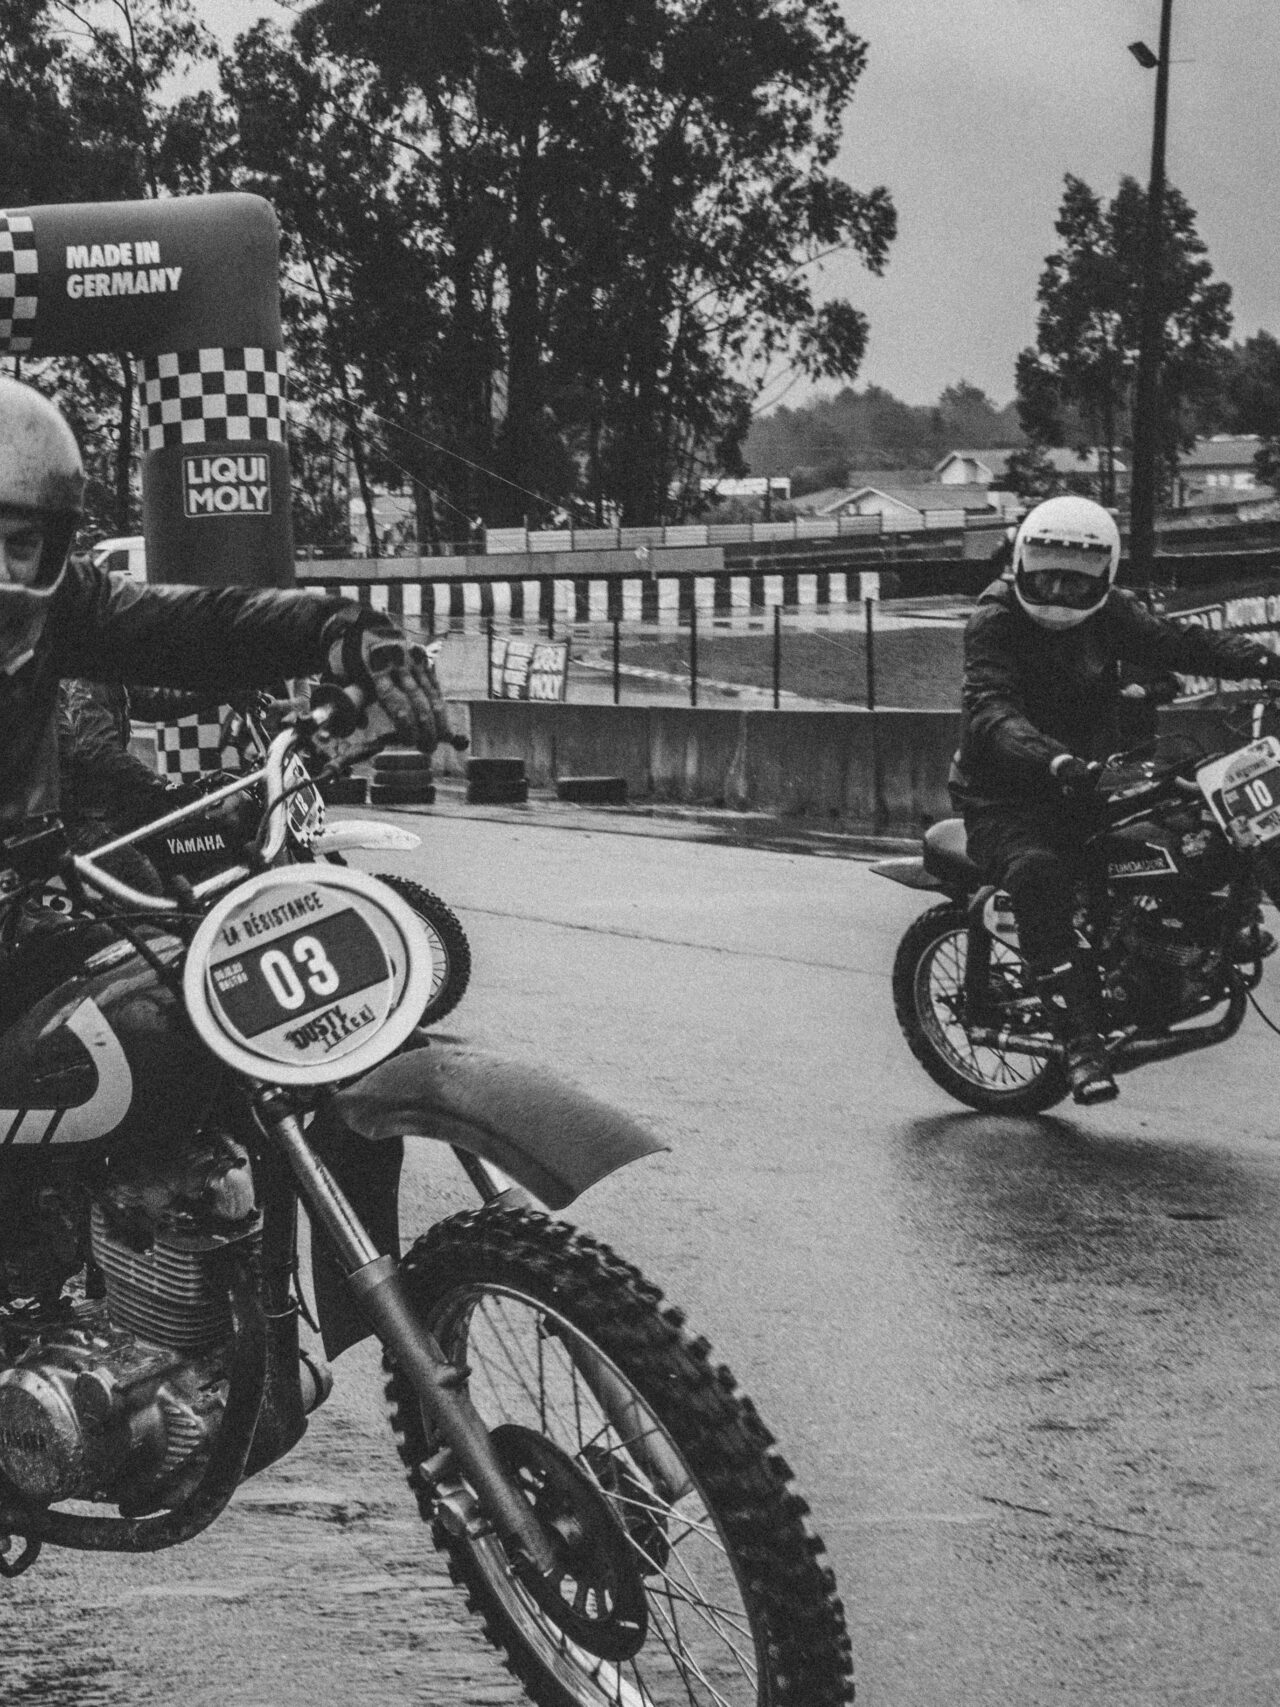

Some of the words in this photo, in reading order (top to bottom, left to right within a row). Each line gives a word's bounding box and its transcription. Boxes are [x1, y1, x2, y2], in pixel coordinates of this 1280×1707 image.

[65, 242, 134, 269] MADE
[133, 240, 161, 265] IN
[66, 266, 183, 299] GERMANY
[186, 456, 266, 485] LIQUI
[188, 485, 269, 514] MOLY
[1243, 779, 1273, 812] 10
[166, 833, 226, 855] YAMAHA
[221, 926, 242, 946] LA
[242, 891, 324, 938] RÉSISTANCE
[259, 934, 340, 1010] 03
[284, 1004, 347, 1050] DUSTY
